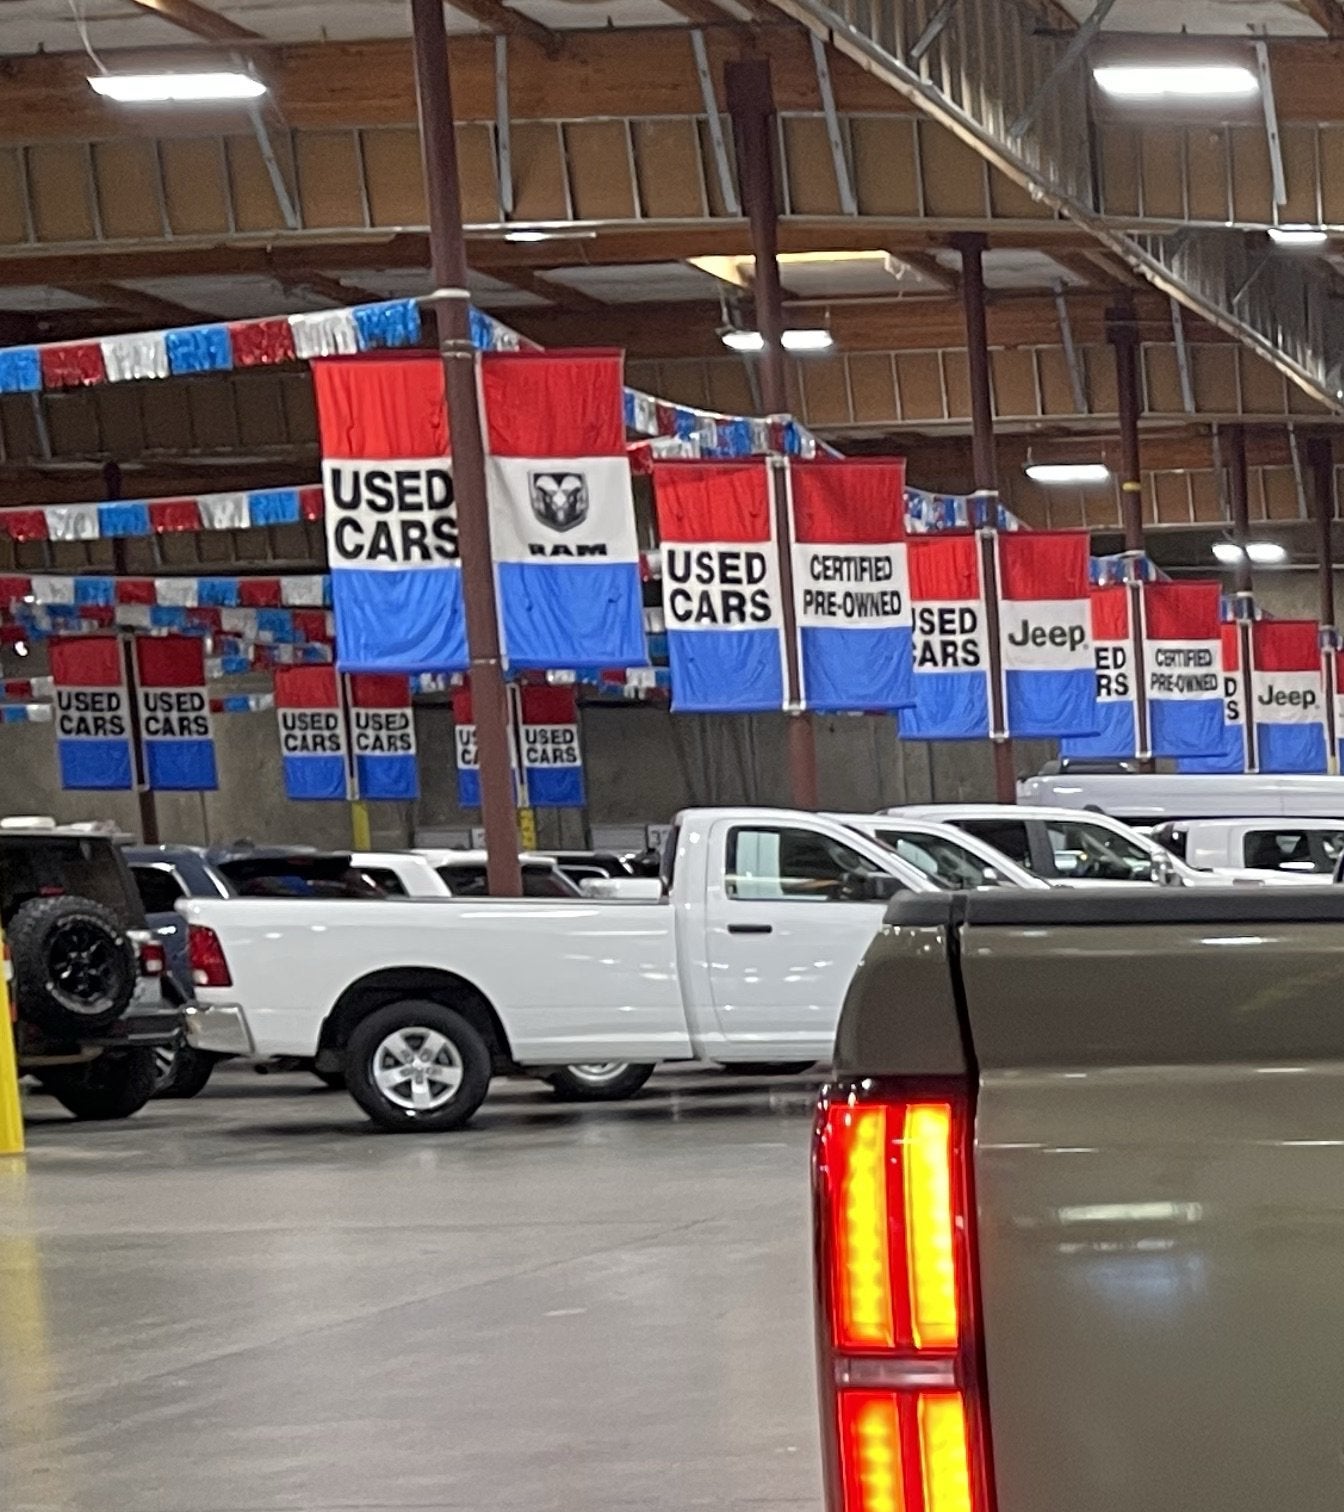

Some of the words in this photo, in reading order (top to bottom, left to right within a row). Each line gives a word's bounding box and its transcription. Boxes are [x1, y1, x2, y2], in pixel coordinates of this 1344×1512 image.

[330, 468, 454, 513] USED
[334, 516, 460, 561] CARS
[667, 550, 767, 585] USED
[810, 554, 893, 582] CERTIFIED
[669, 588, 772, 624] CARS
[803, 589, 902, 618] PRE-OWNED
[1007, 619, 1086, 652] Jeep
[912, 639, 980, 667] ARS
[1095, 646, 1127, 669] ED
[1155, 648, 1213, 667] CERTIFIED
[1096, 672, 1129, 696] RS
[1150, 672, 1218, 693] PRE-OWNED
[57, 691, 121, 712] USED
[143, 692, 205, 713] USED
[1257, 684, 1317, 709] Jeep
[59, 714, 125, 736] CARS
[144, 715, 209, 736] CARS
[282, 711, 339, 731] USED
[355, 711, 410, 731] USED
[284, 733, 341, 752] CARS
[356, 733, 412, 752] CARS
[525, 729, 574, 745] USED
[526, 747, 577, 763] CARS
